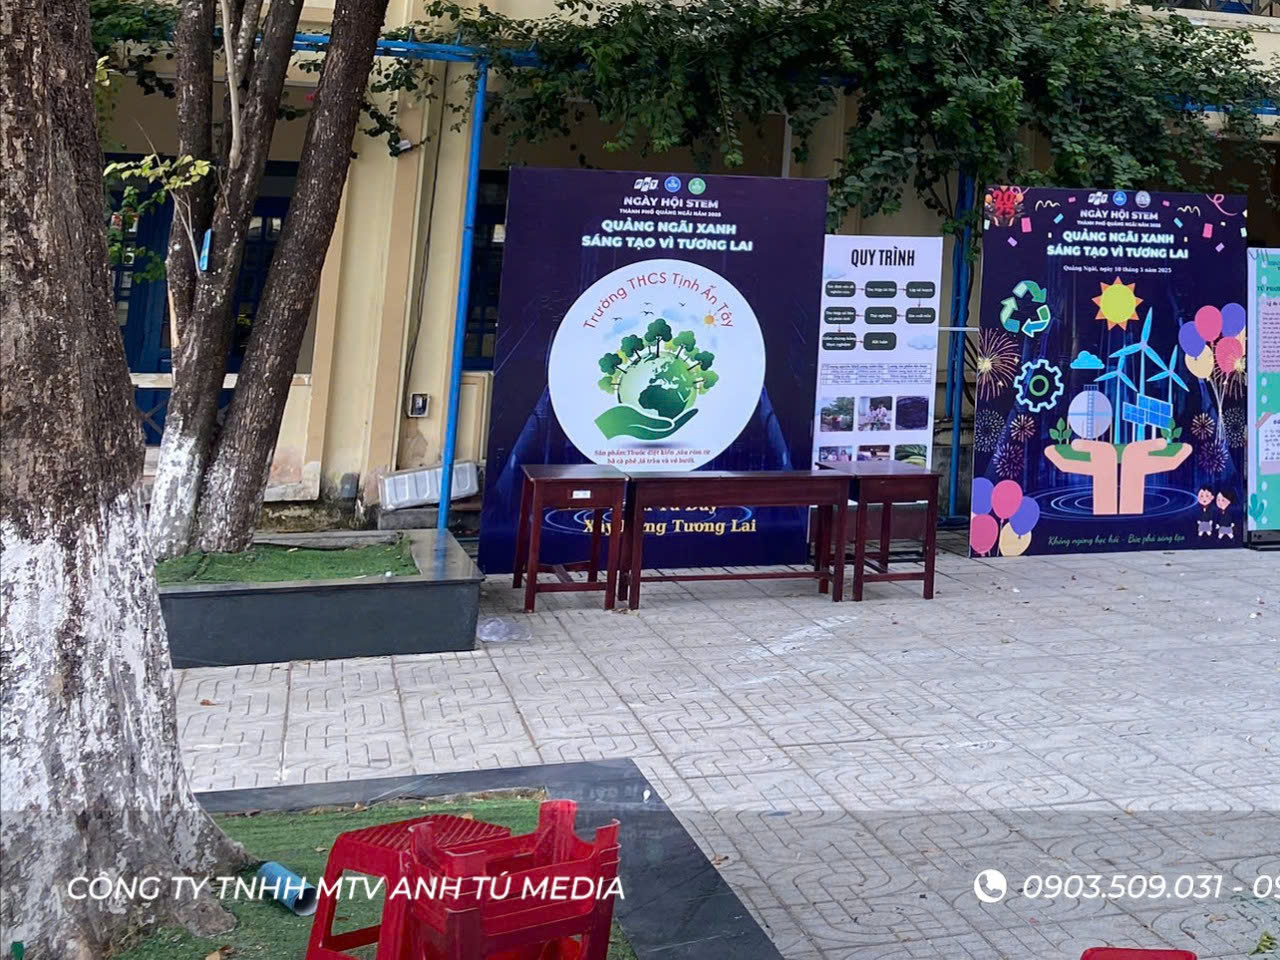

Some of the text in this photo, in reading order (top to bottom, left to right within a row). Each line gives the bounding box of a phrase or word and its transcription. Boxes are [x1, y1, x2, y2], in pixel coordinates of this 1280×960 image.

[623, 195, 719, 209] NGÀY HỘI STEM
[1080, 208, 1158, 221] NGÀY HỘI STEM
[601, 217, 737, 235] QUẢNG NGÃI XANH
[581, 233, 753, 251] SÁNG TẠO VÌ TƯƠNG LAI
[1062, 228, 1174, 244] QUẢNG NGÃI XANH
[851, 246, 915, 267] QUY TRÌNH
[1047, 243, 1189, 259] SÁNG TẠO VÌ TƯƠNG LAI
[583, 287, 628, 330] Trường
[627, 272, 667, 290] THCS
[672, 273, 699, 292] Tịnh
[716, 302, 733, 328] Tây
[730, 519, 756, 532] Lai
